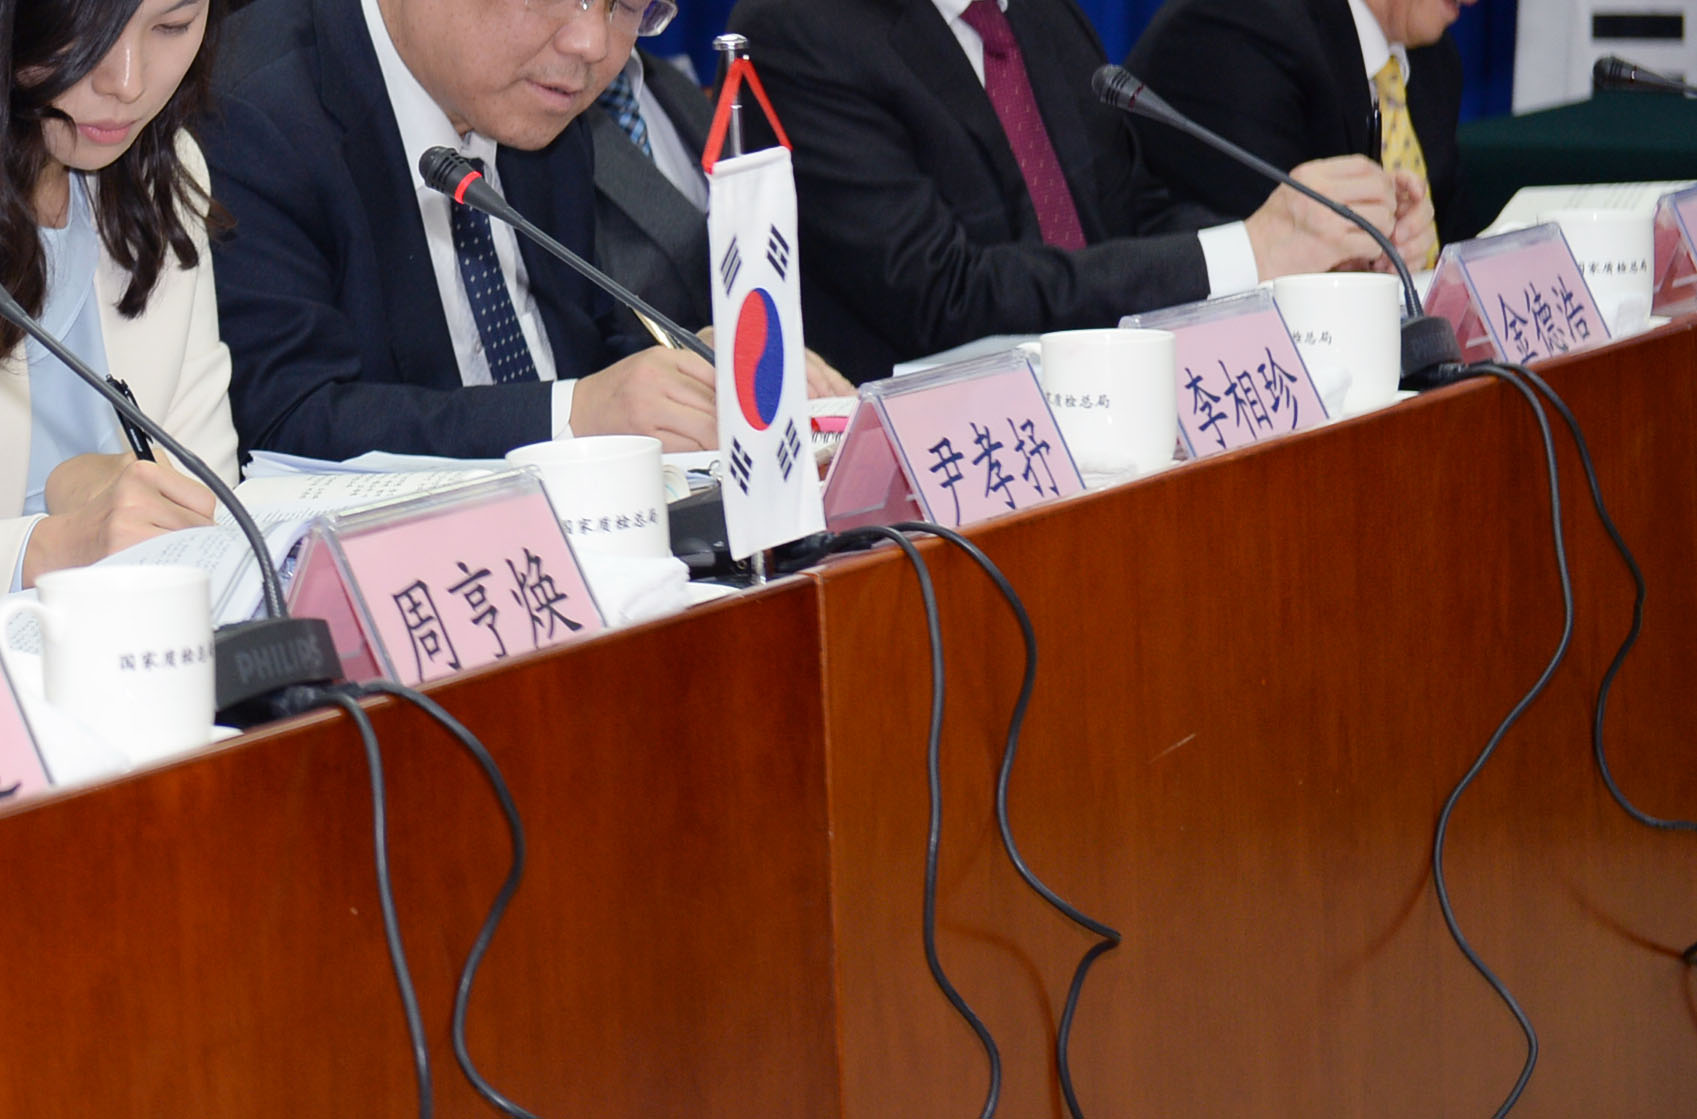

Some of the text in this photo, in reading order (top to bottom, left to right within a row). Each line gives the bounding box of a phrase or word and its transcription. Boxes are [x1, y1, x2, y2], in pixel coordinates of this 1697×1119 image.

[1184, 346, 1298, 449] 李相珍
[234, 633, 323, 685] PHILIPS
[392, 547, 583, 683] 周亨焕
